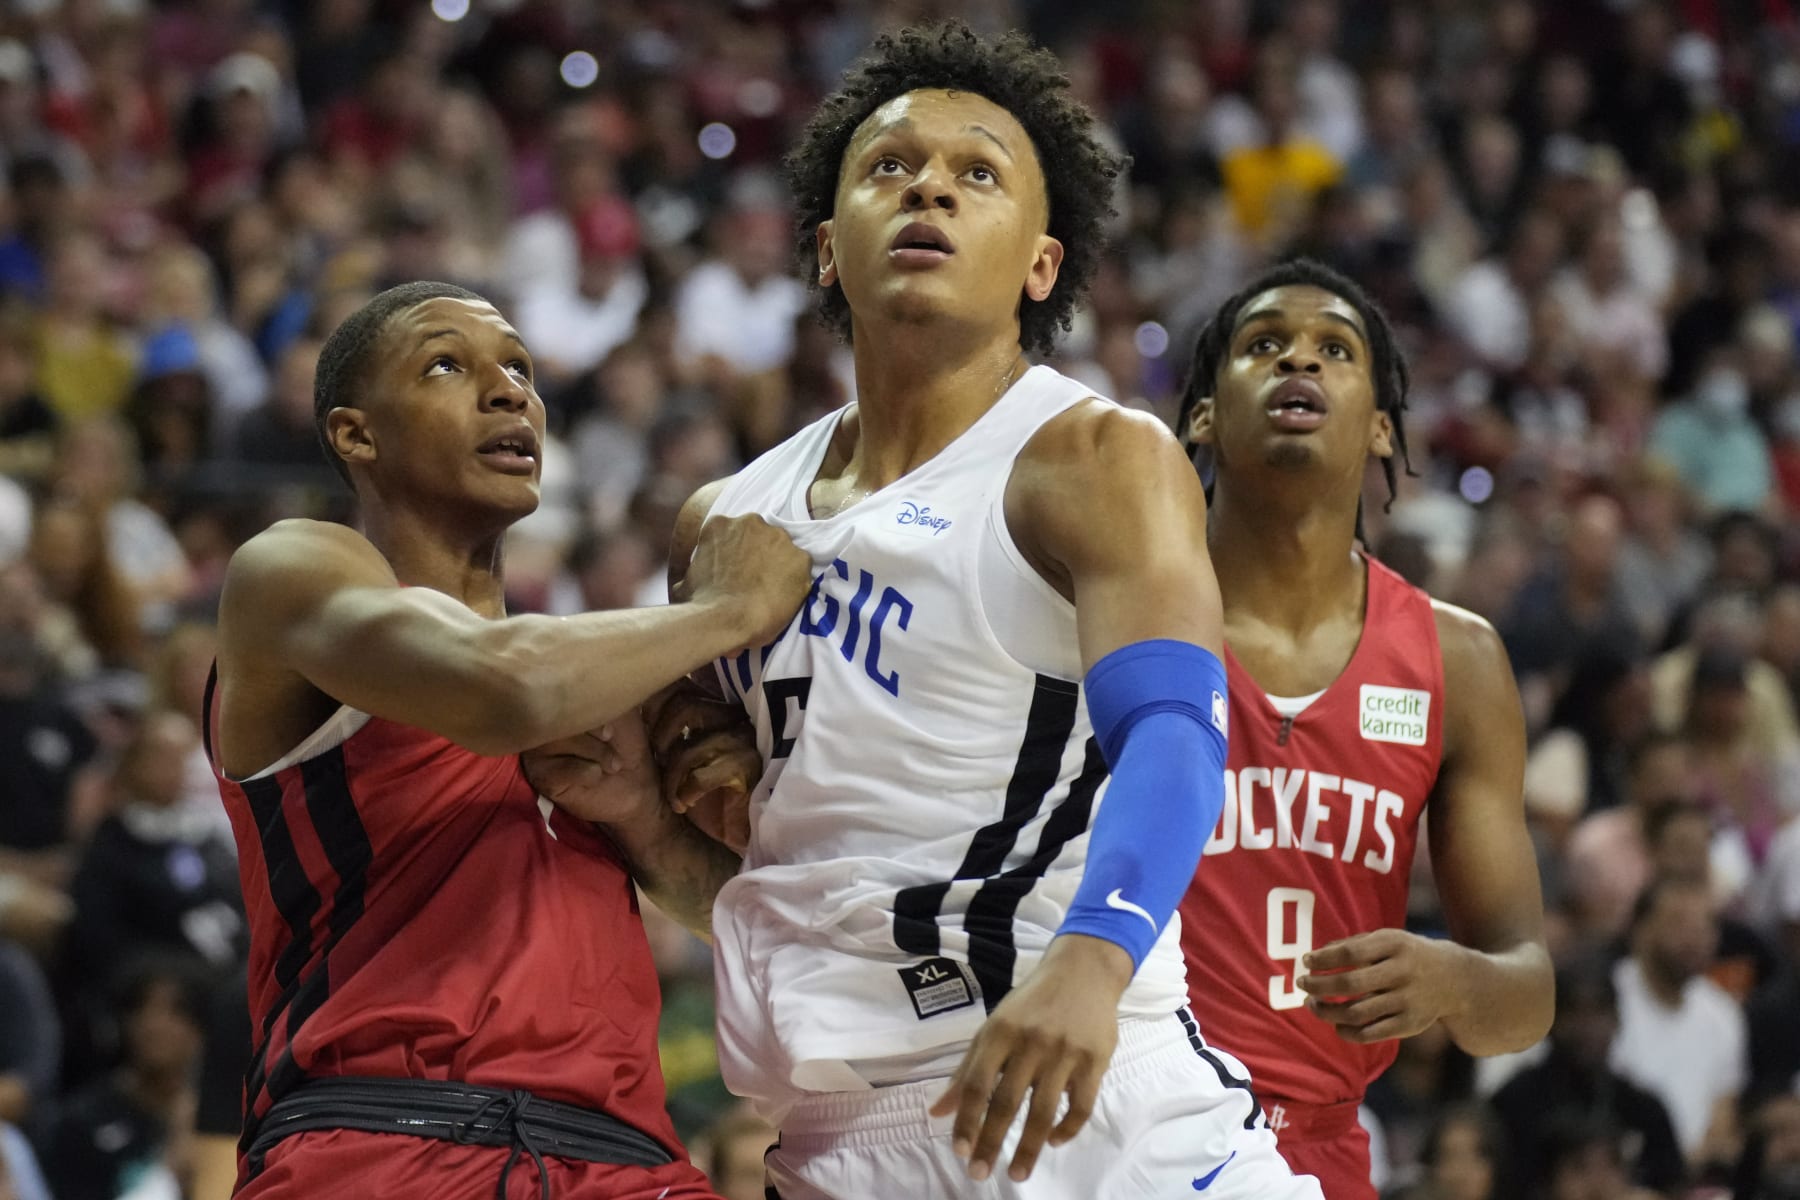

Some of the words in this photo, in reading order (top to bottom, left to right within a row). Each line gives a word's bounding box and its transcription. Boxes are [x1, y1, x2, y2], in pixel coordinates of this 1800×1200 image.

[1366, 694, 1421, 716] credit
[1362, 712, 1423, 739] karma
[1202, 766, 1404, 874] OCKETS
[1267, 887, 1315, 1011] 9
[915, 965, 949, 984] XL
